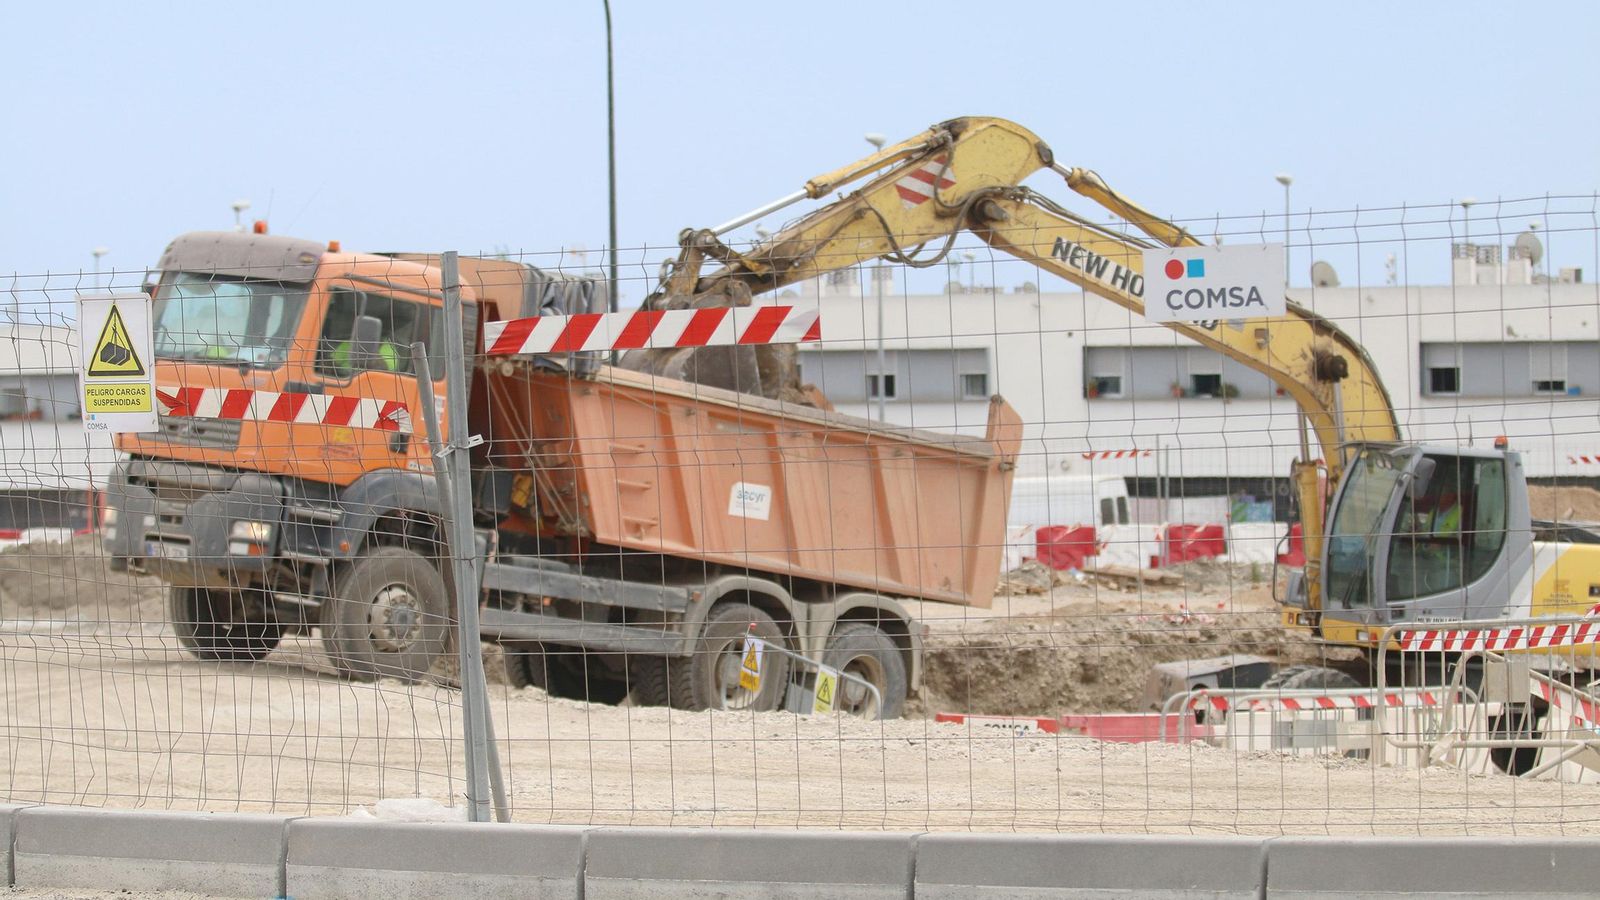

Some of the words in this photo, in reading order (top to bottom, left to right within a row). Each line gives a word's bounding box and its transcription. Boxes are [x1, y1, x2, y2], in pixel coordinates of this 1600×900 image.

[1051, 236, 1110, 280] NEW
[1166, 286, 1265, 311] COMSA
[86, 388, 114, 396] PELIGRO
[116, 387, 146, 396] CARGAS
[93, 398, 141, 407] SUSPENDIDAS
[86, 422, 109, 430] COMSA
